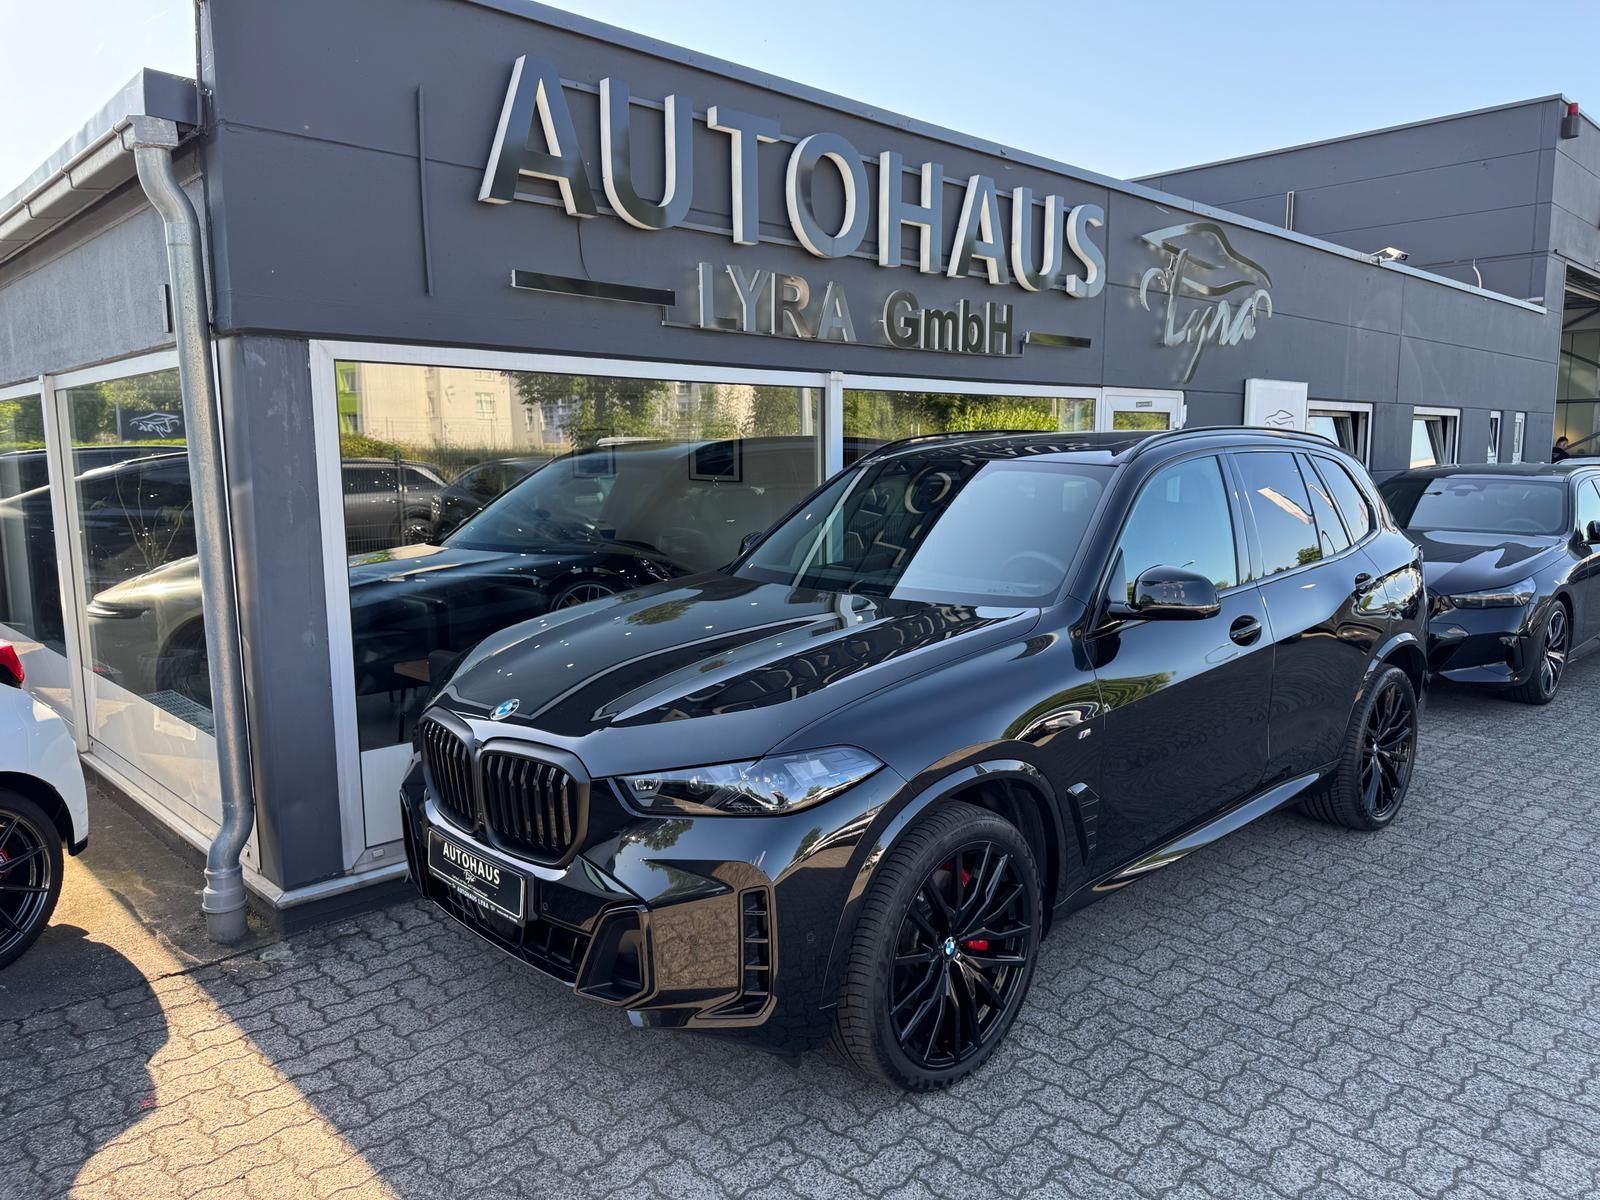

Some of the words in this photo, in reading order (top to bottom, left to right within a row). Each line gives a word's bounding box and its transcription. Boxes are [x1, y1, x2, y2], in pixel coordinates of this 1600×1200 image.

[478, 54, 1106, 298] AUTOHAUS
[698, 262, 857, 342] LYRA
[883, 289, 1014, 355] GmbH
[442, 841, 500, 885] AUTOHAUS
